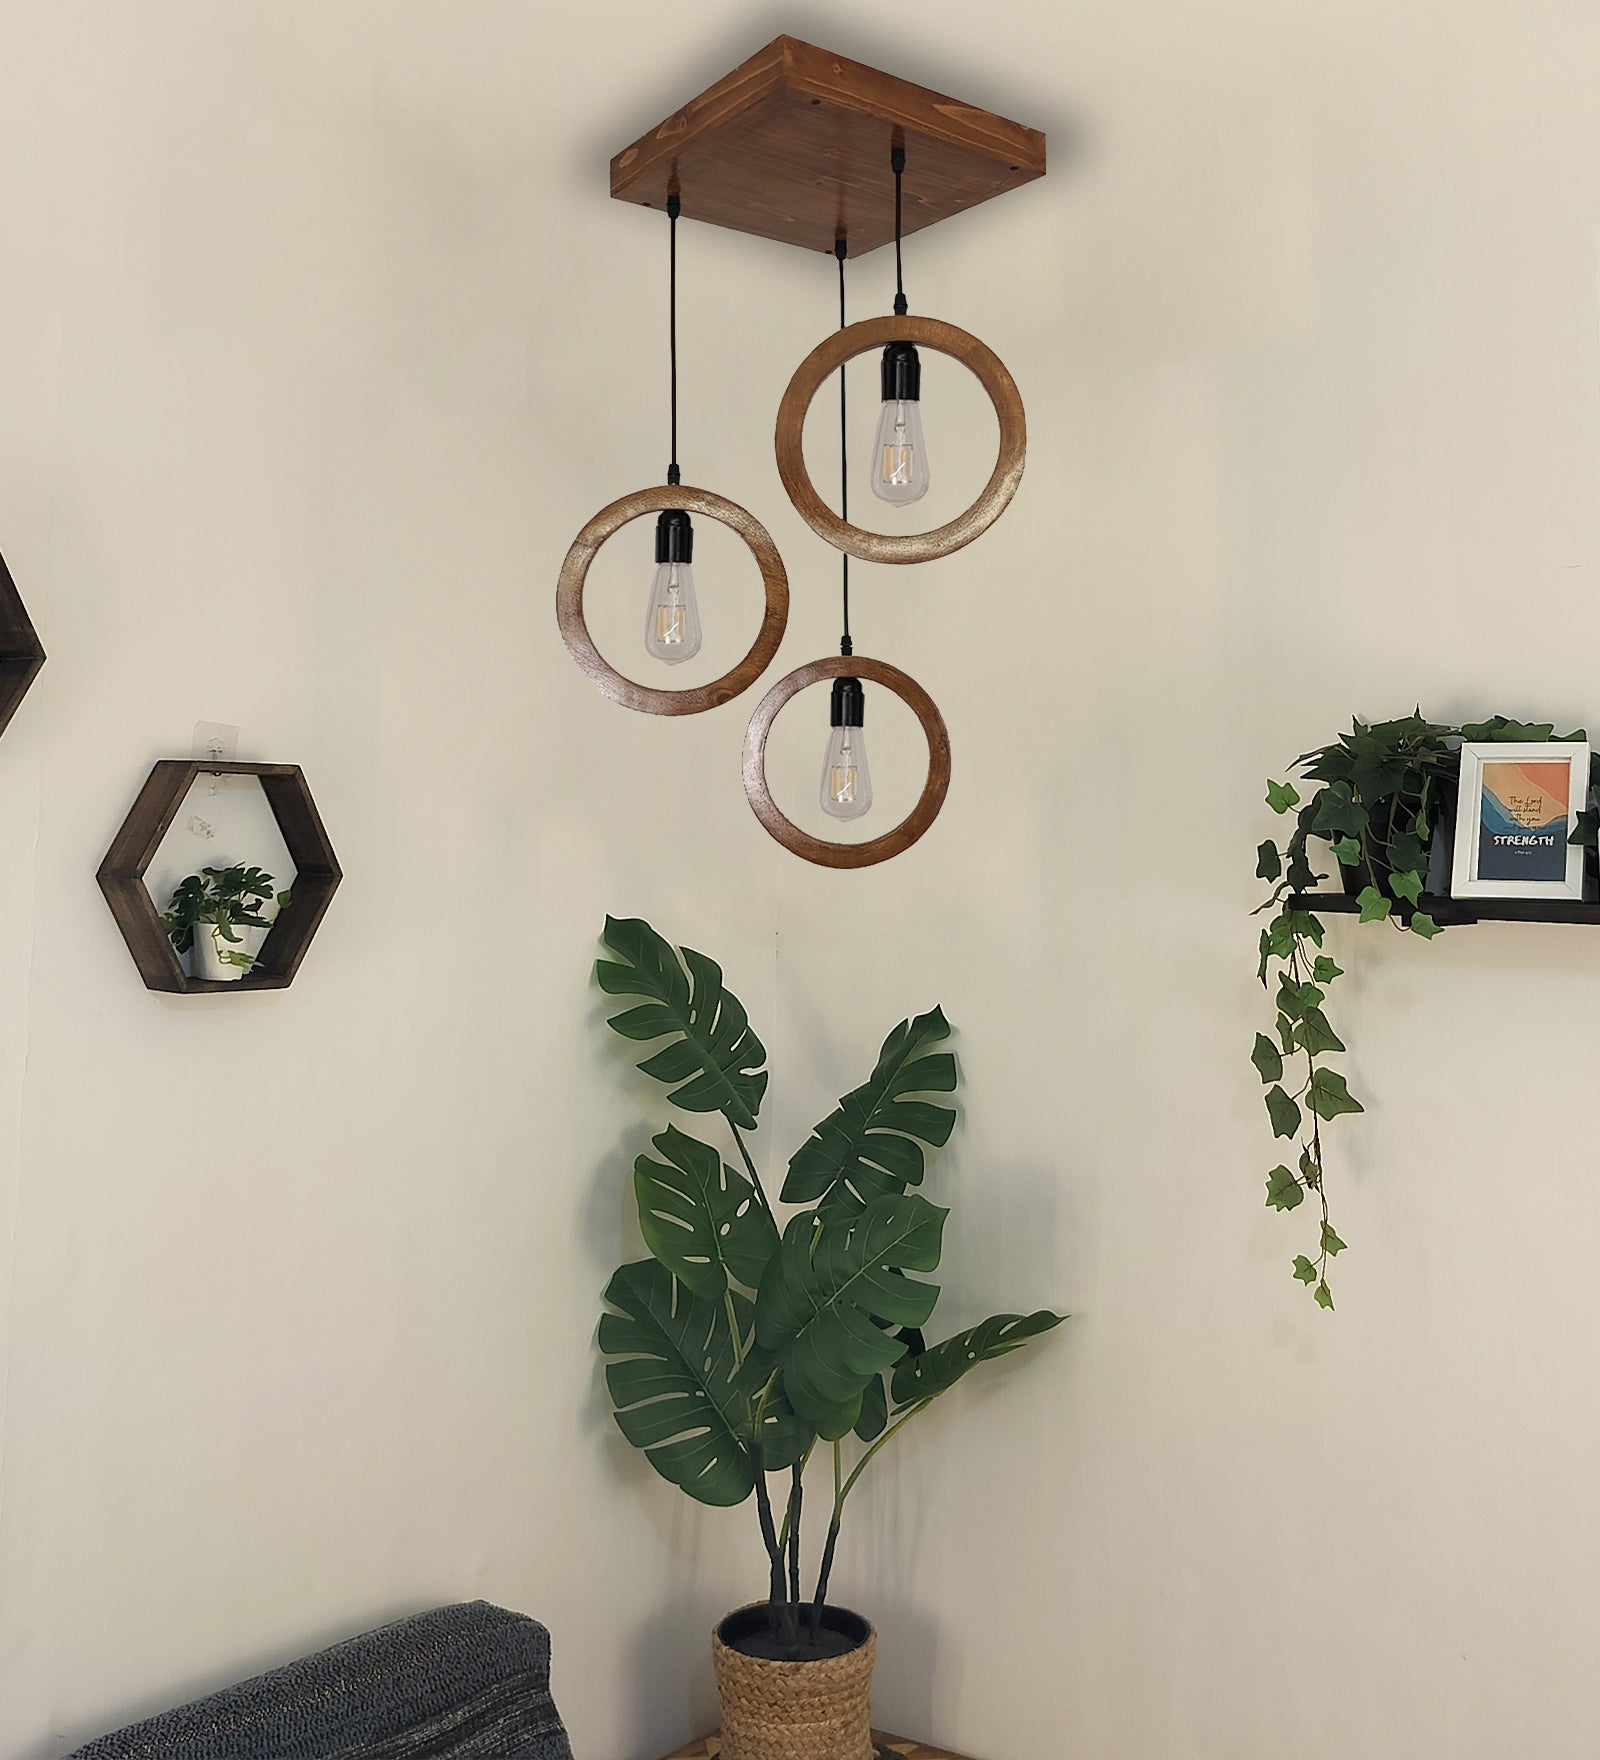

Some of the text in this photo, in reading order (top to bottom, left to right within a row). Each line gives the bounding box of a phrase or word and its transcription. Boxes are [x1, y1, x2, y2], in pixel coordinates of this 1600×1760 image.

[1509, 796, 1542, 805] The Lord
[1523, 804, 1541, 813] stand
[1493, 835, 1554, 846] STRENGTH
